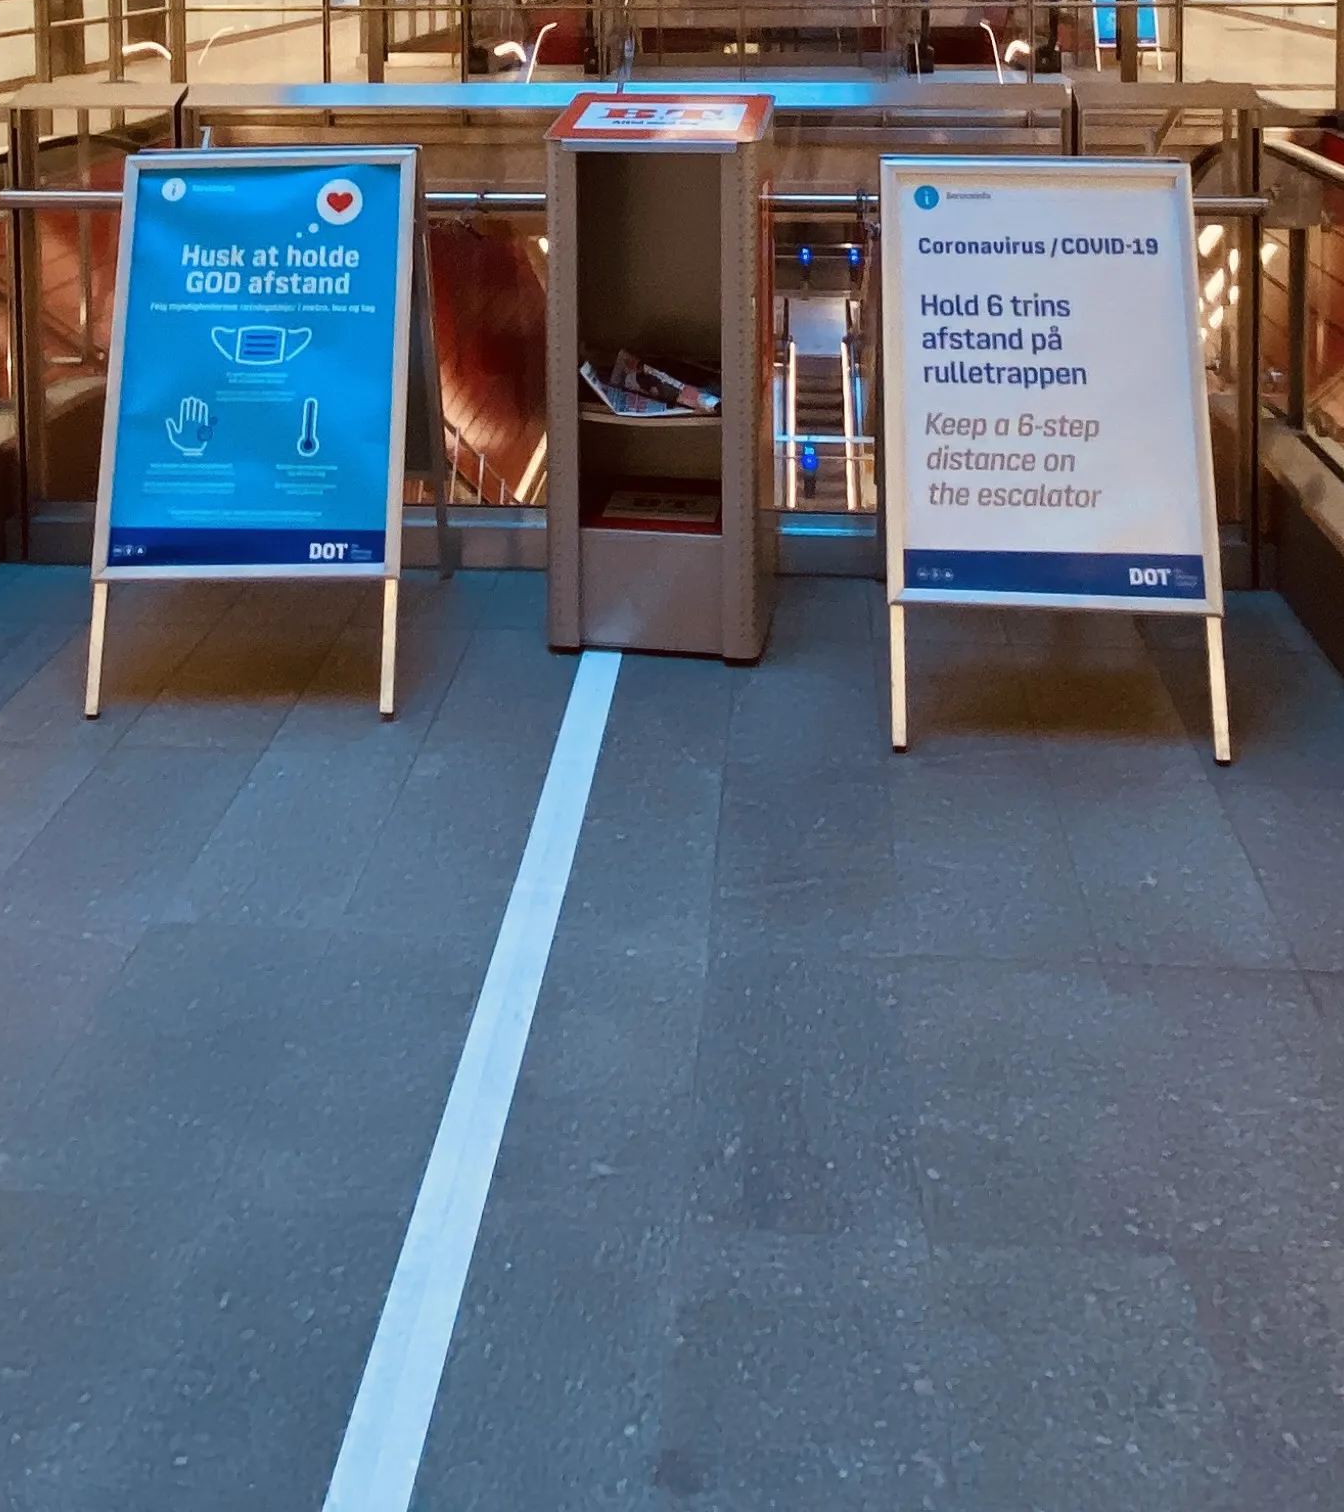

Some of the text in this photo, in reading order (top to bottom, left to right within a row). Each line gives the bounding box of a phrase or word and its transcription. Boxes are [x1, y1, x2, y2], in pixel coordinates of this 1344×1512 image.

[181, 244, 360, 268] Husk at holde
[918, 236, 1046, 255] Coronavirus
[186, 270, 350, 294] GOD afstand
[921, 292, 1071, 318] Hold 6 trins
[922, 325, 1063, 356] afstand på
[923, 360, 1087, 390] rulletrappen
[925, 411, 1100, 443] Keep a 6-step
[926, 444, 1076, 473] distance on
[928, 481, 1102, 509] the escalator
[309, 542, 348, 560] DOT
[1129, 567, 1171, 586] DOT
